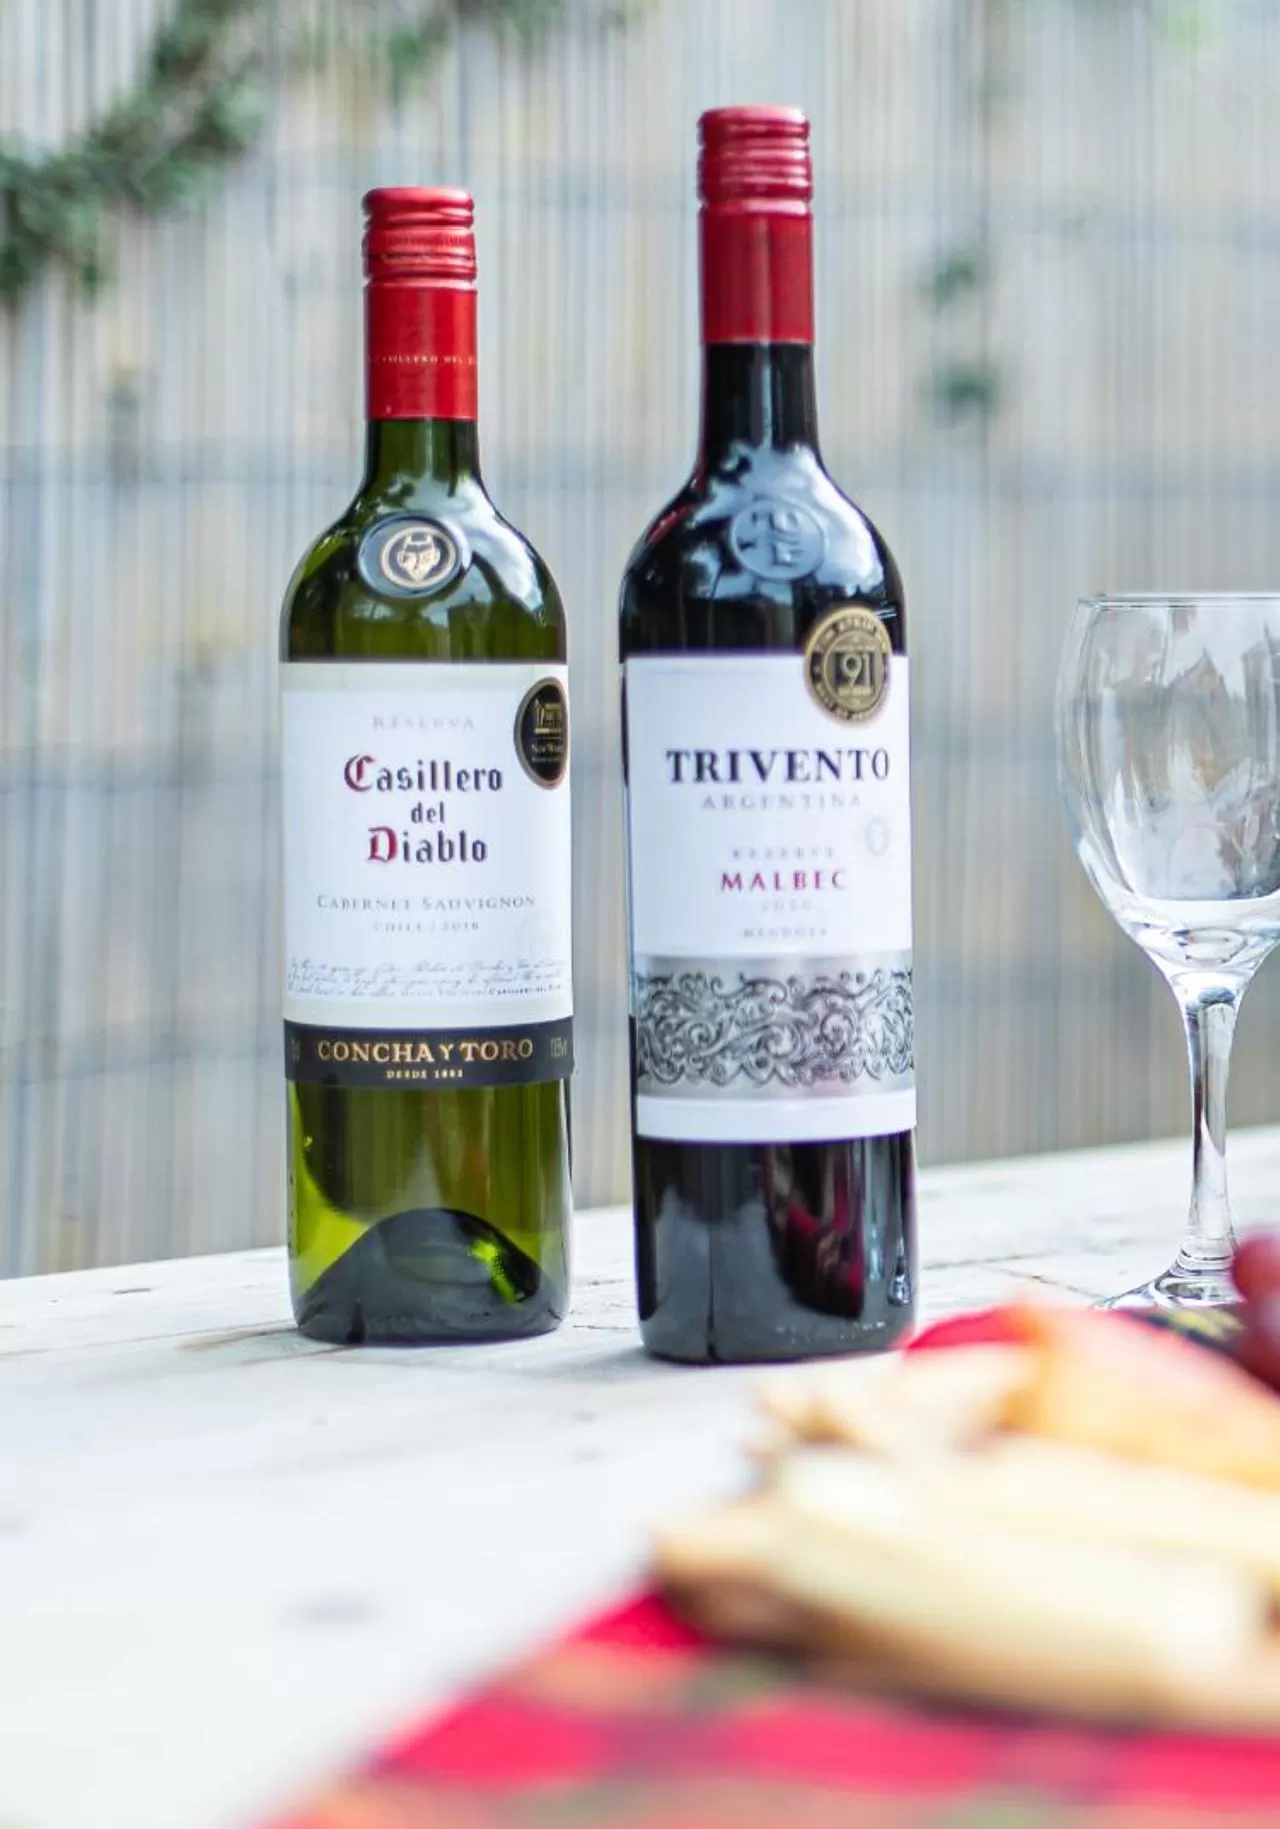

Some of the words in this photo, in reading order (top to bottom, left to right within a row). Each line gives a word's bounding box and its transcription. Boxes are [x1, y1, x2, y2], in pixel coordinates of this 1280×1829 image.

[343, 753, 503, 793] Casillero
[666, 749, 890, 783] TRIVENTO
[410, 802, 446, 824] del
[702, 793, 862, 811] ARGENTINA
[367, 826, 488, 864] Diablo
[720, 870, 848, 893] MALBEC
[317, 894, 412, 911] CABERNET
[422, 894, 536, 911] SAUVIGNON
[317, 1040, 436, 1064] CONCHA
[438, 1042, 455, 1062] Y
[459, 1037, 534, 1063] TORO
